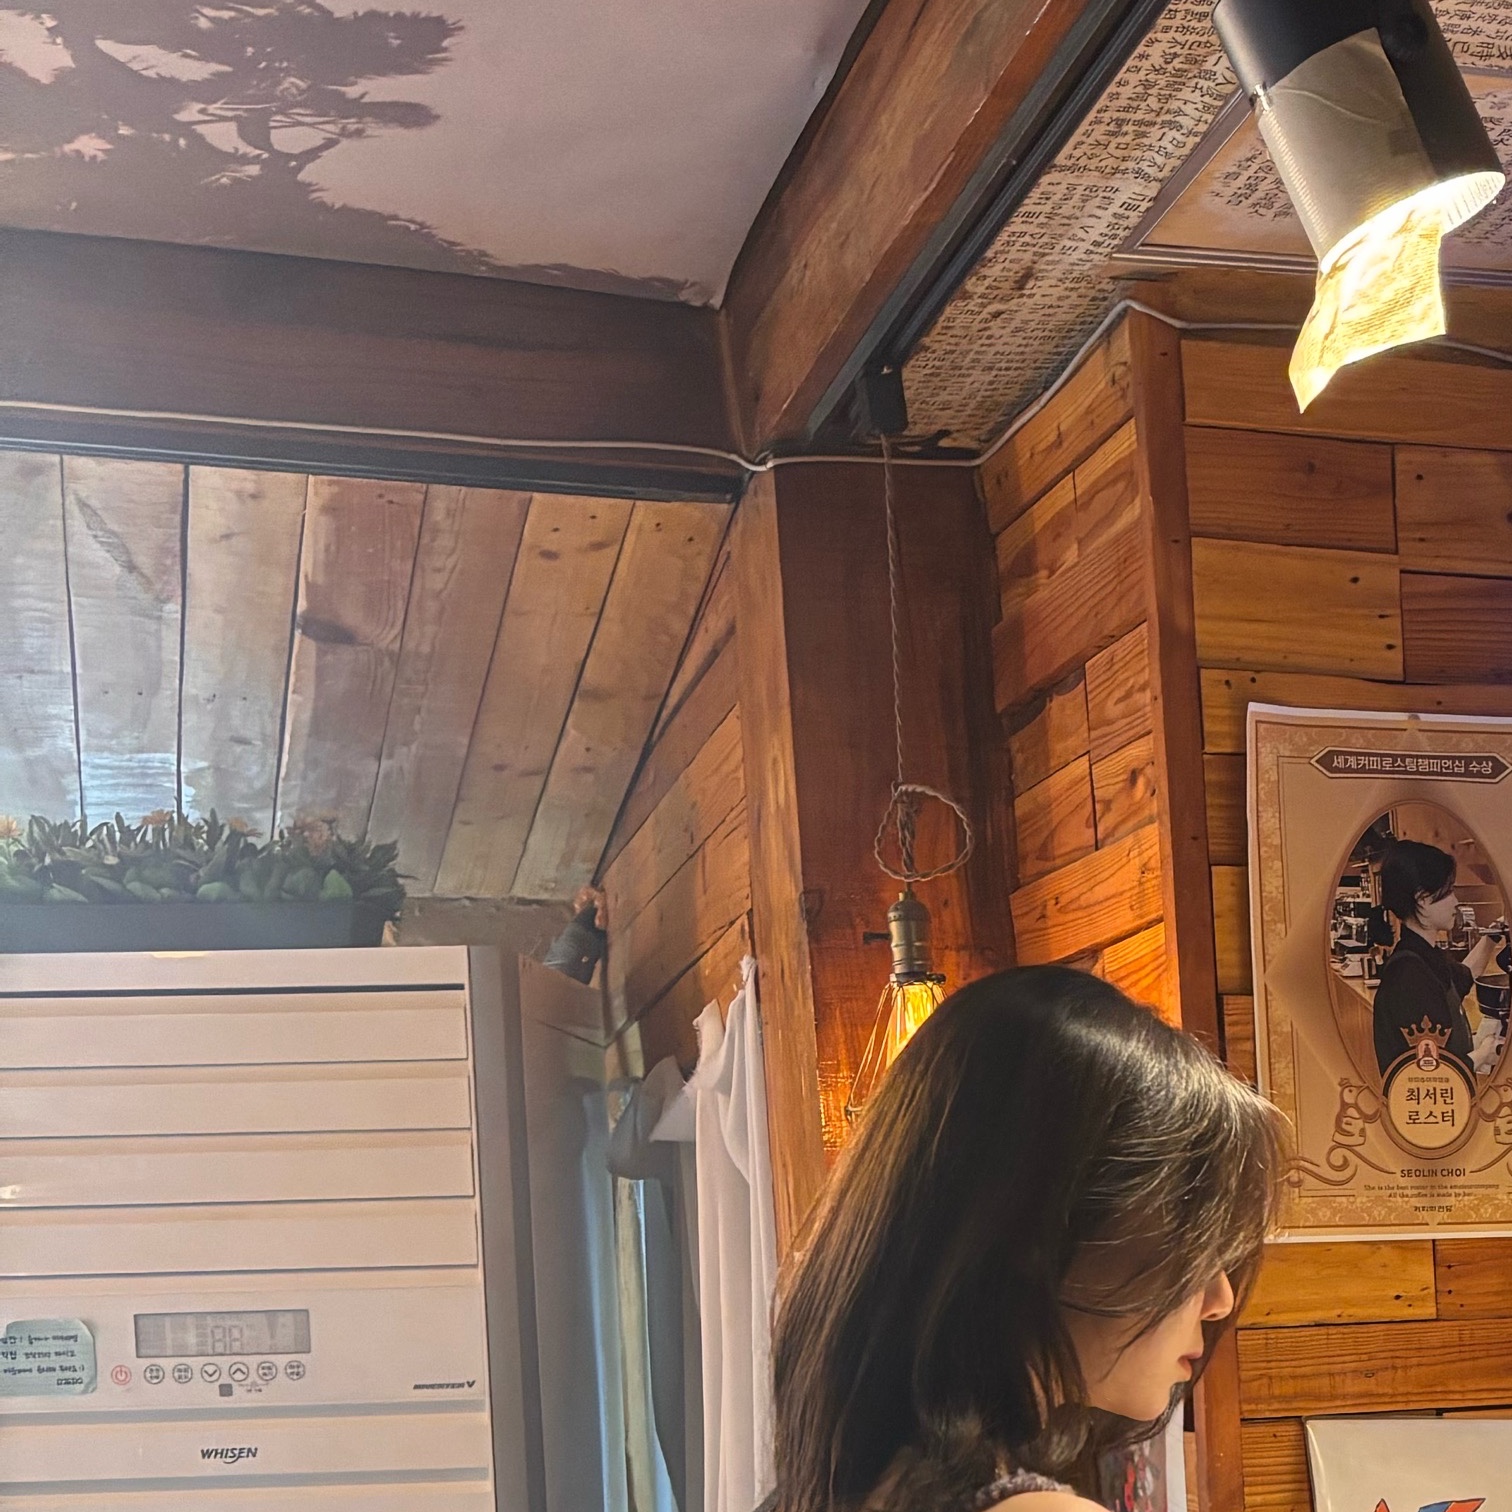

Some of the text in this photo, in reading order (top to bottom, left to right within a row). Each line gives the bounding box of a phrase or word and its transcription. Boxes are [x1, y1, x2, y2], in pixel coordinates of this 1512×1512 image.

[1468, 759, 1493, 774] 수상
[1405, 1086, 1455, 1106] 최서린
[1405, 1109, 1455, 1127] 로스터
[1400, 1167, 1466, 1178] SEOLIN CHOI
[200, 1447, 258, 1464] WHISEN
